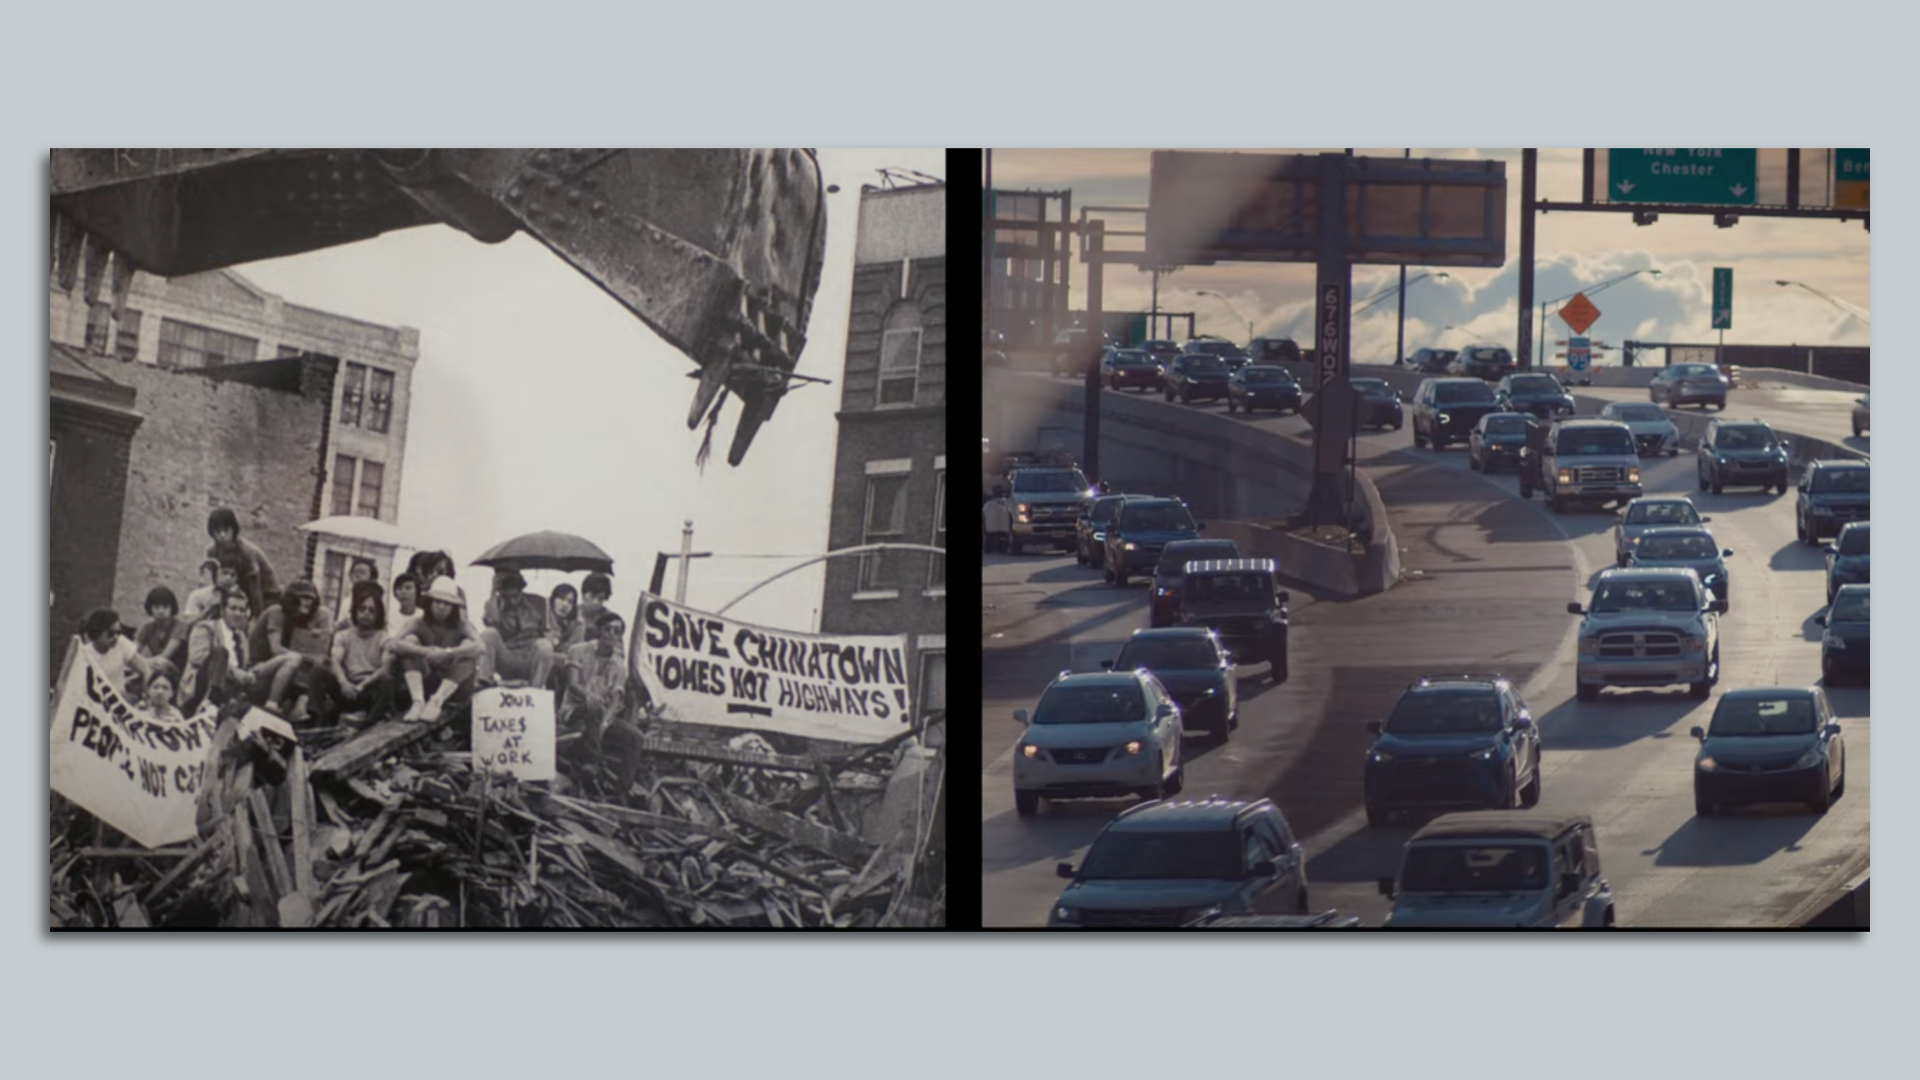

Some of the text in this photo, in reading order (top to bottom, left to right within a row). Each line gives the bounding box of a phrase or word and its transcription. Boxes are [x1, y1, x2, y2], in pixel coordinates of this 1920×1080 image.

[1688, 148, 1722, 157] York
[1651, 161, 1714, 176] Chester
[1569, 353, 1588, 367] 95
[645, 601, 905, 685] SAVE CHINATOWN
[730, 666, 770, 703] NOT
[499, 692, 535, 708] YOUR
[503, 735, 522, 749] AT
[480, 750, 532, 765] WORK
[137, 755, 167, 798] NOT
